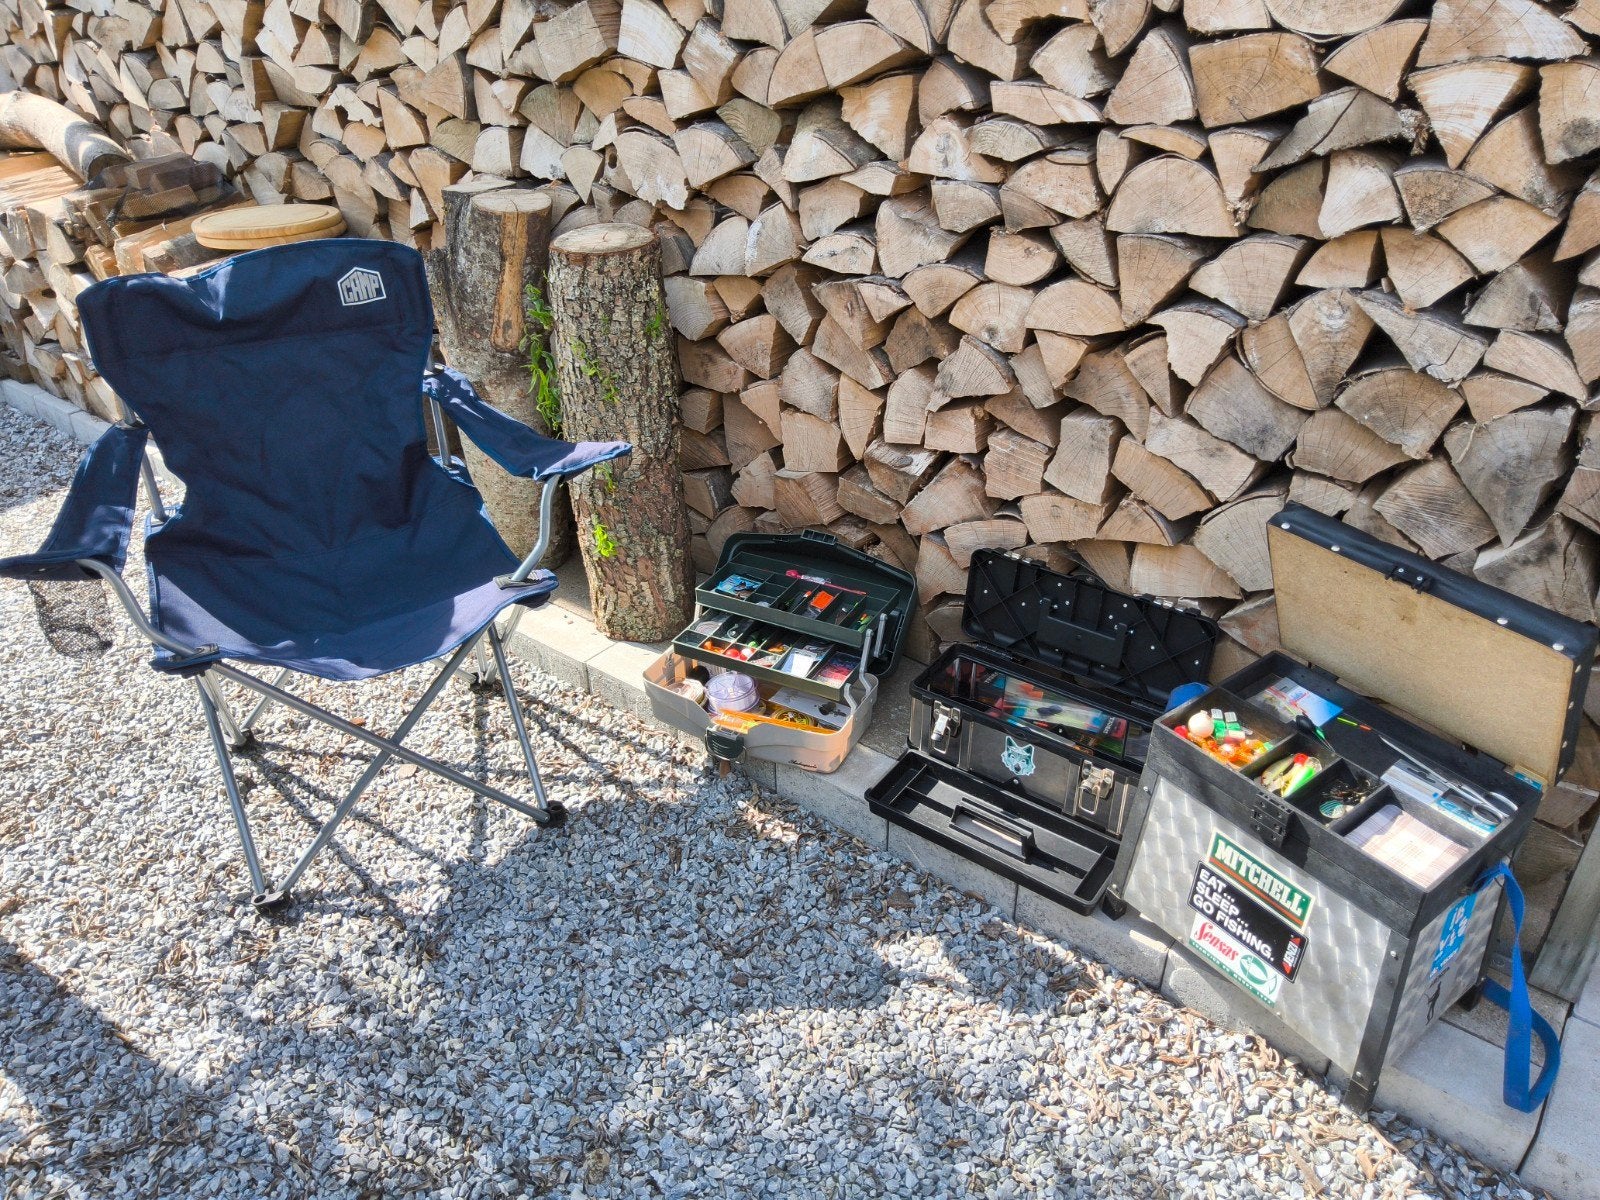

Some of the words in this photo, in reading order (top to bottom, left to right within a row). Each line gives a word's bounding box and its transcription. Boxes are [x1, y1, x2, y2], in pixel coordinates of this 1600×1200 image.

[341, 271, 380, 303] CAMP
[1215, 838, 1304, 917] MITCHELL
[1193, 893, 1215, 915] GO
[1215, 910, 1274, 962] FISHING.
[1195, 921, 1239, 961] Sensas
